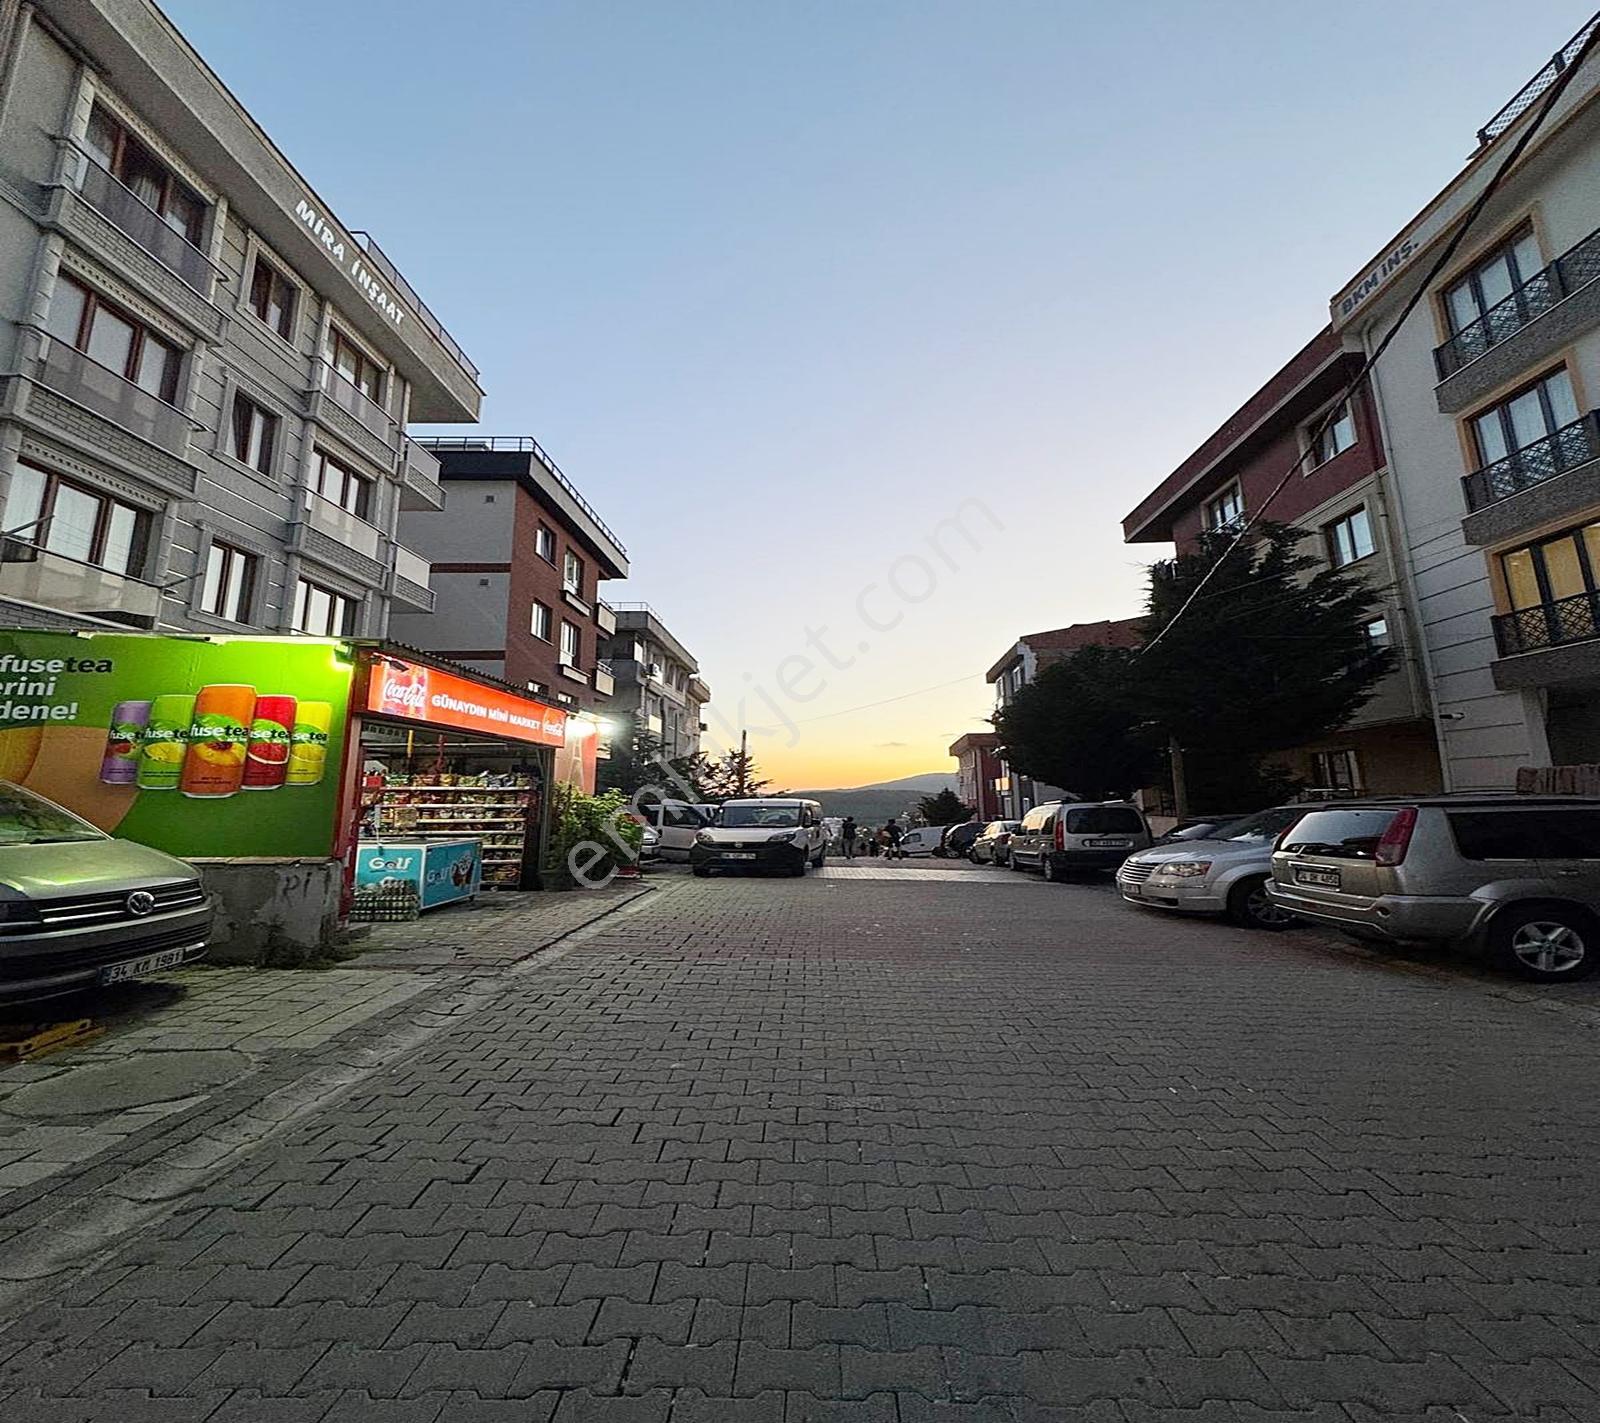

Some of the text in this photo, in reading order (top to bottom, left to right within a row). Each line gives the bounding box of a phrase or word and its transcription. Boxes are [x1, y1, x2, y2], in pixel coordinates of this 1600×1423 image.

[1342, 272, 1378, 315] BKM
[431, 693, 487, 718] GÜNAYDIN
[509, 713, 541, 730] MARKET
